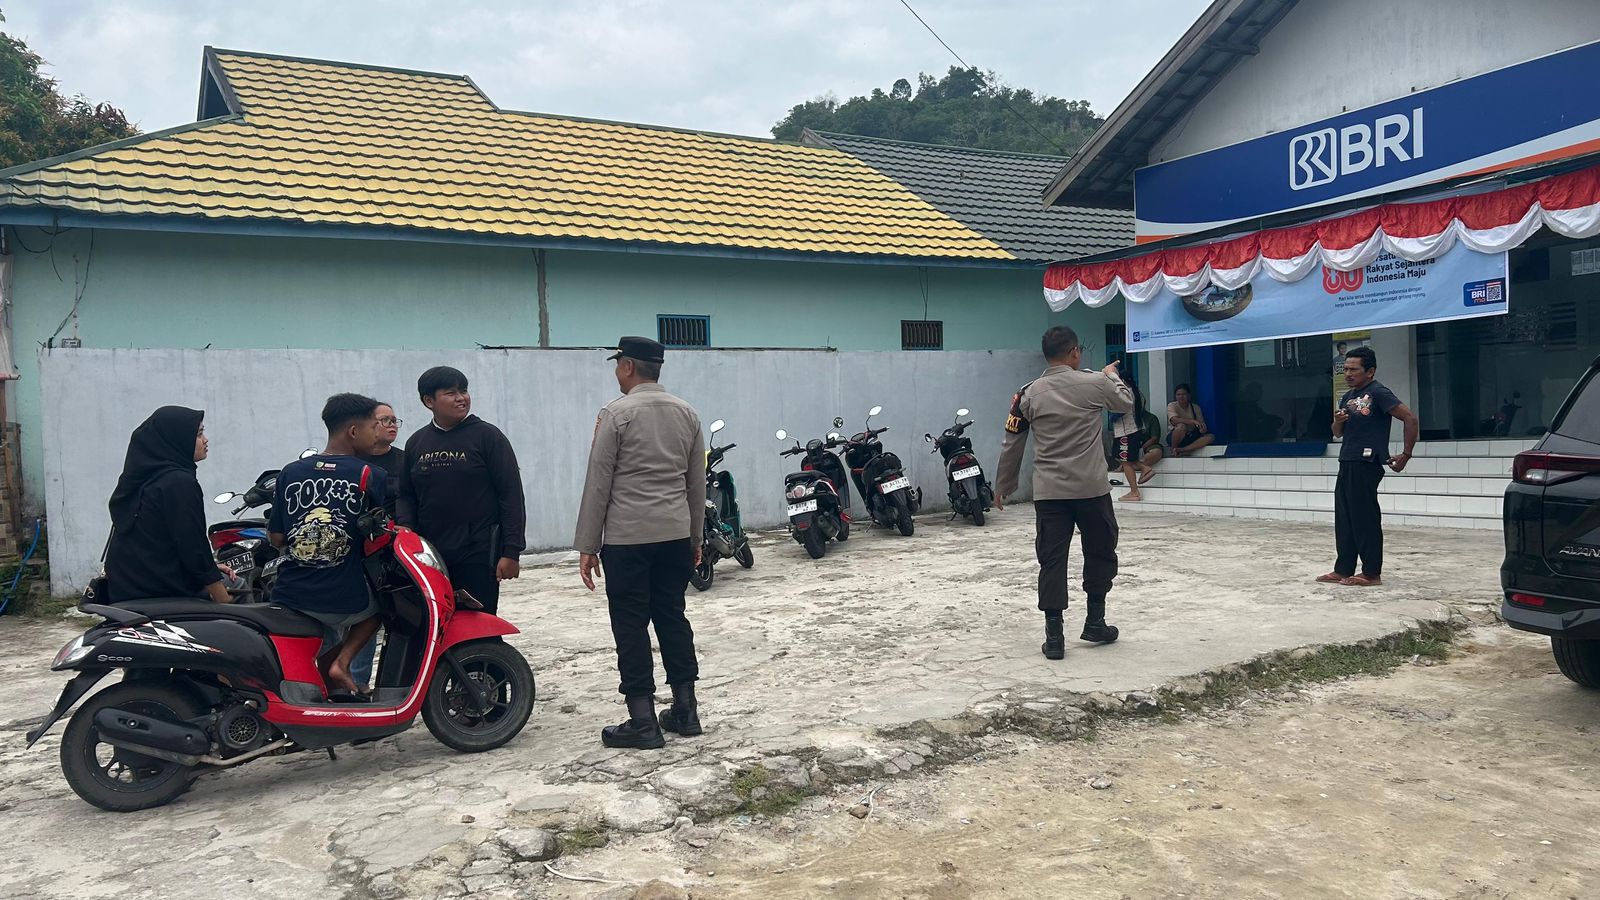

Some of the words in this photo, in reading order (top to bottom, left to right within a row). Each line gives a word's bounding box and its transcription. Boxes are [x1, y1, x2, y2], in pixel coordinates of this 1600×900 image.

[1340, 107, 1423, 176] BRI
[1366, 263, 1394, 274] Rakyat
[1366, 271, 1406, 284] Indonesia
[1408, 268, 1426, 278] Maju
[1472, 290, 1486, 298] BRI
[417, 451, 468, 464] ARIZONA
